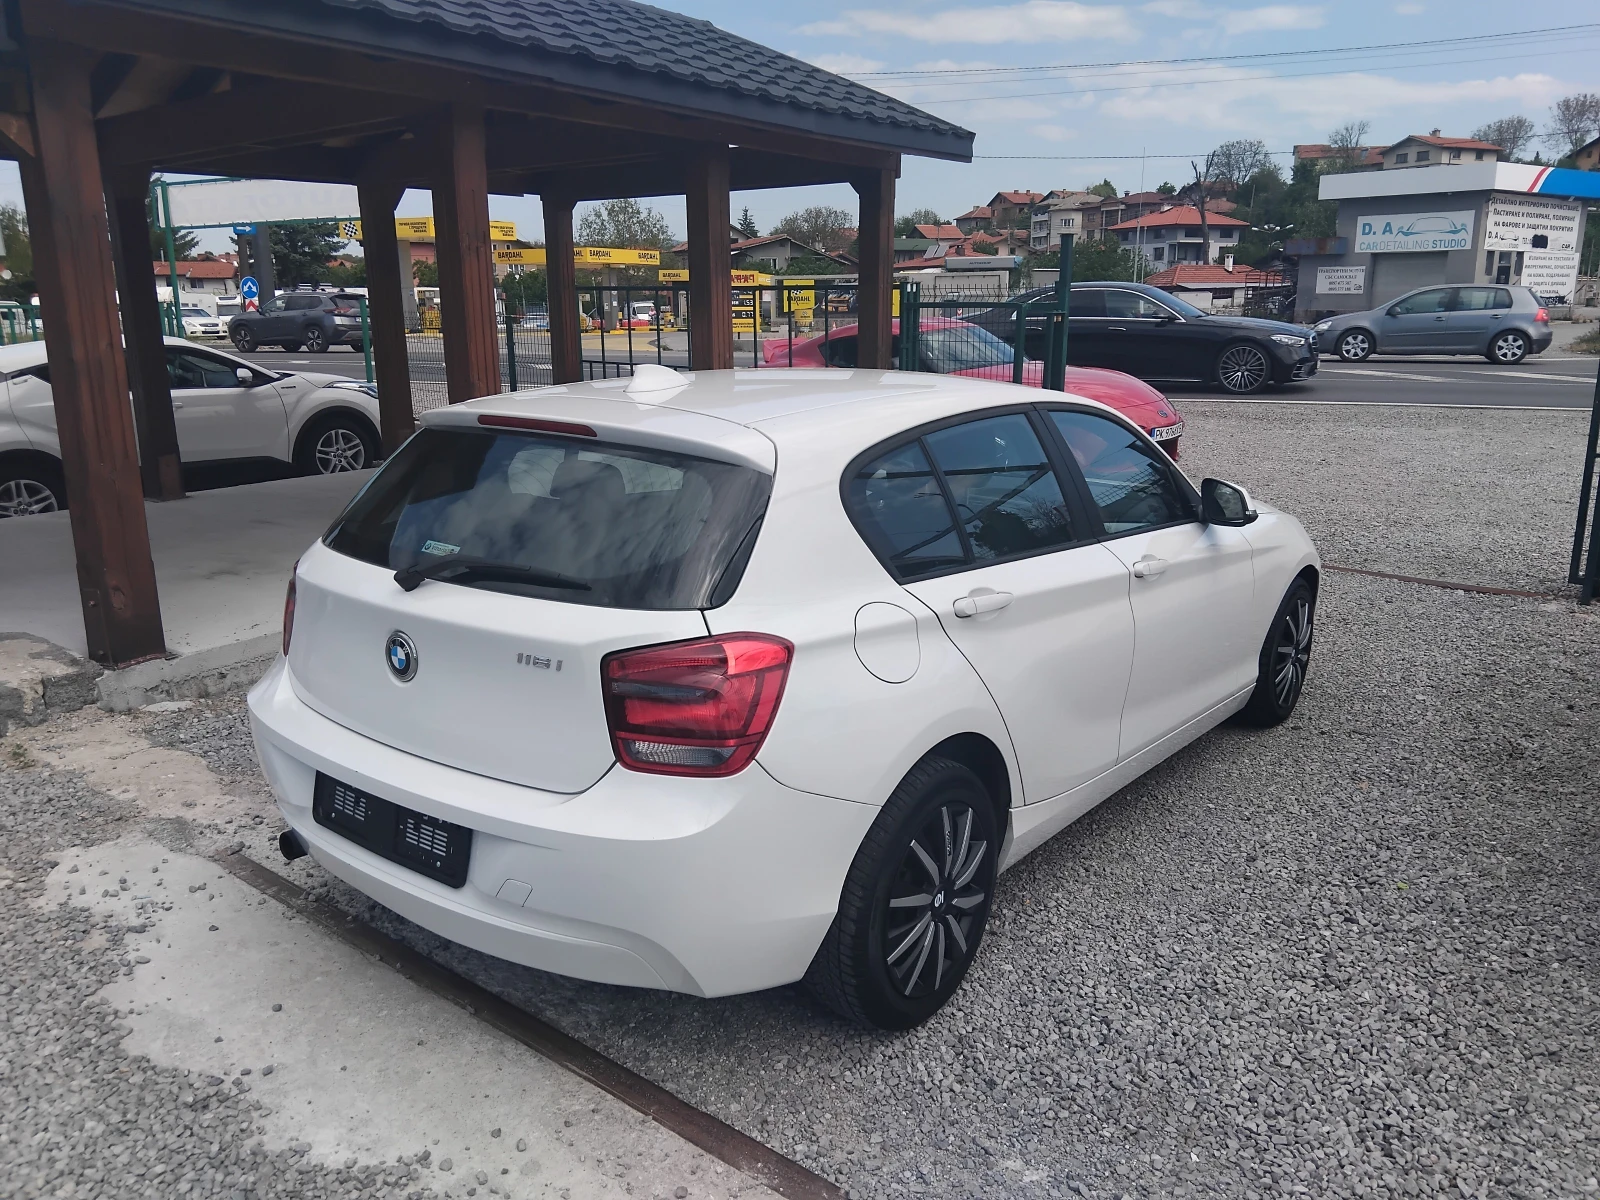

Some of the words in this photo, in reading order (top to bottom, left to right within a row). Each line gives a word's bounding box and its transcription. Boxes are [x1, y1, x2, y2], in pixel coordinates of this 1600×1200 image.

[1362, 222, 1376, 236] D.
[1382, 221, 1394, 235] A
[1431, 238, 1467, 249] STUDIO
[497, 250, 523, 261] BARDAHL
[589, 249, 612, 260] BARDAHL
[638, 251, 658, 262] BARDAHL
[787, 296, 811, 305] ARDAHL
